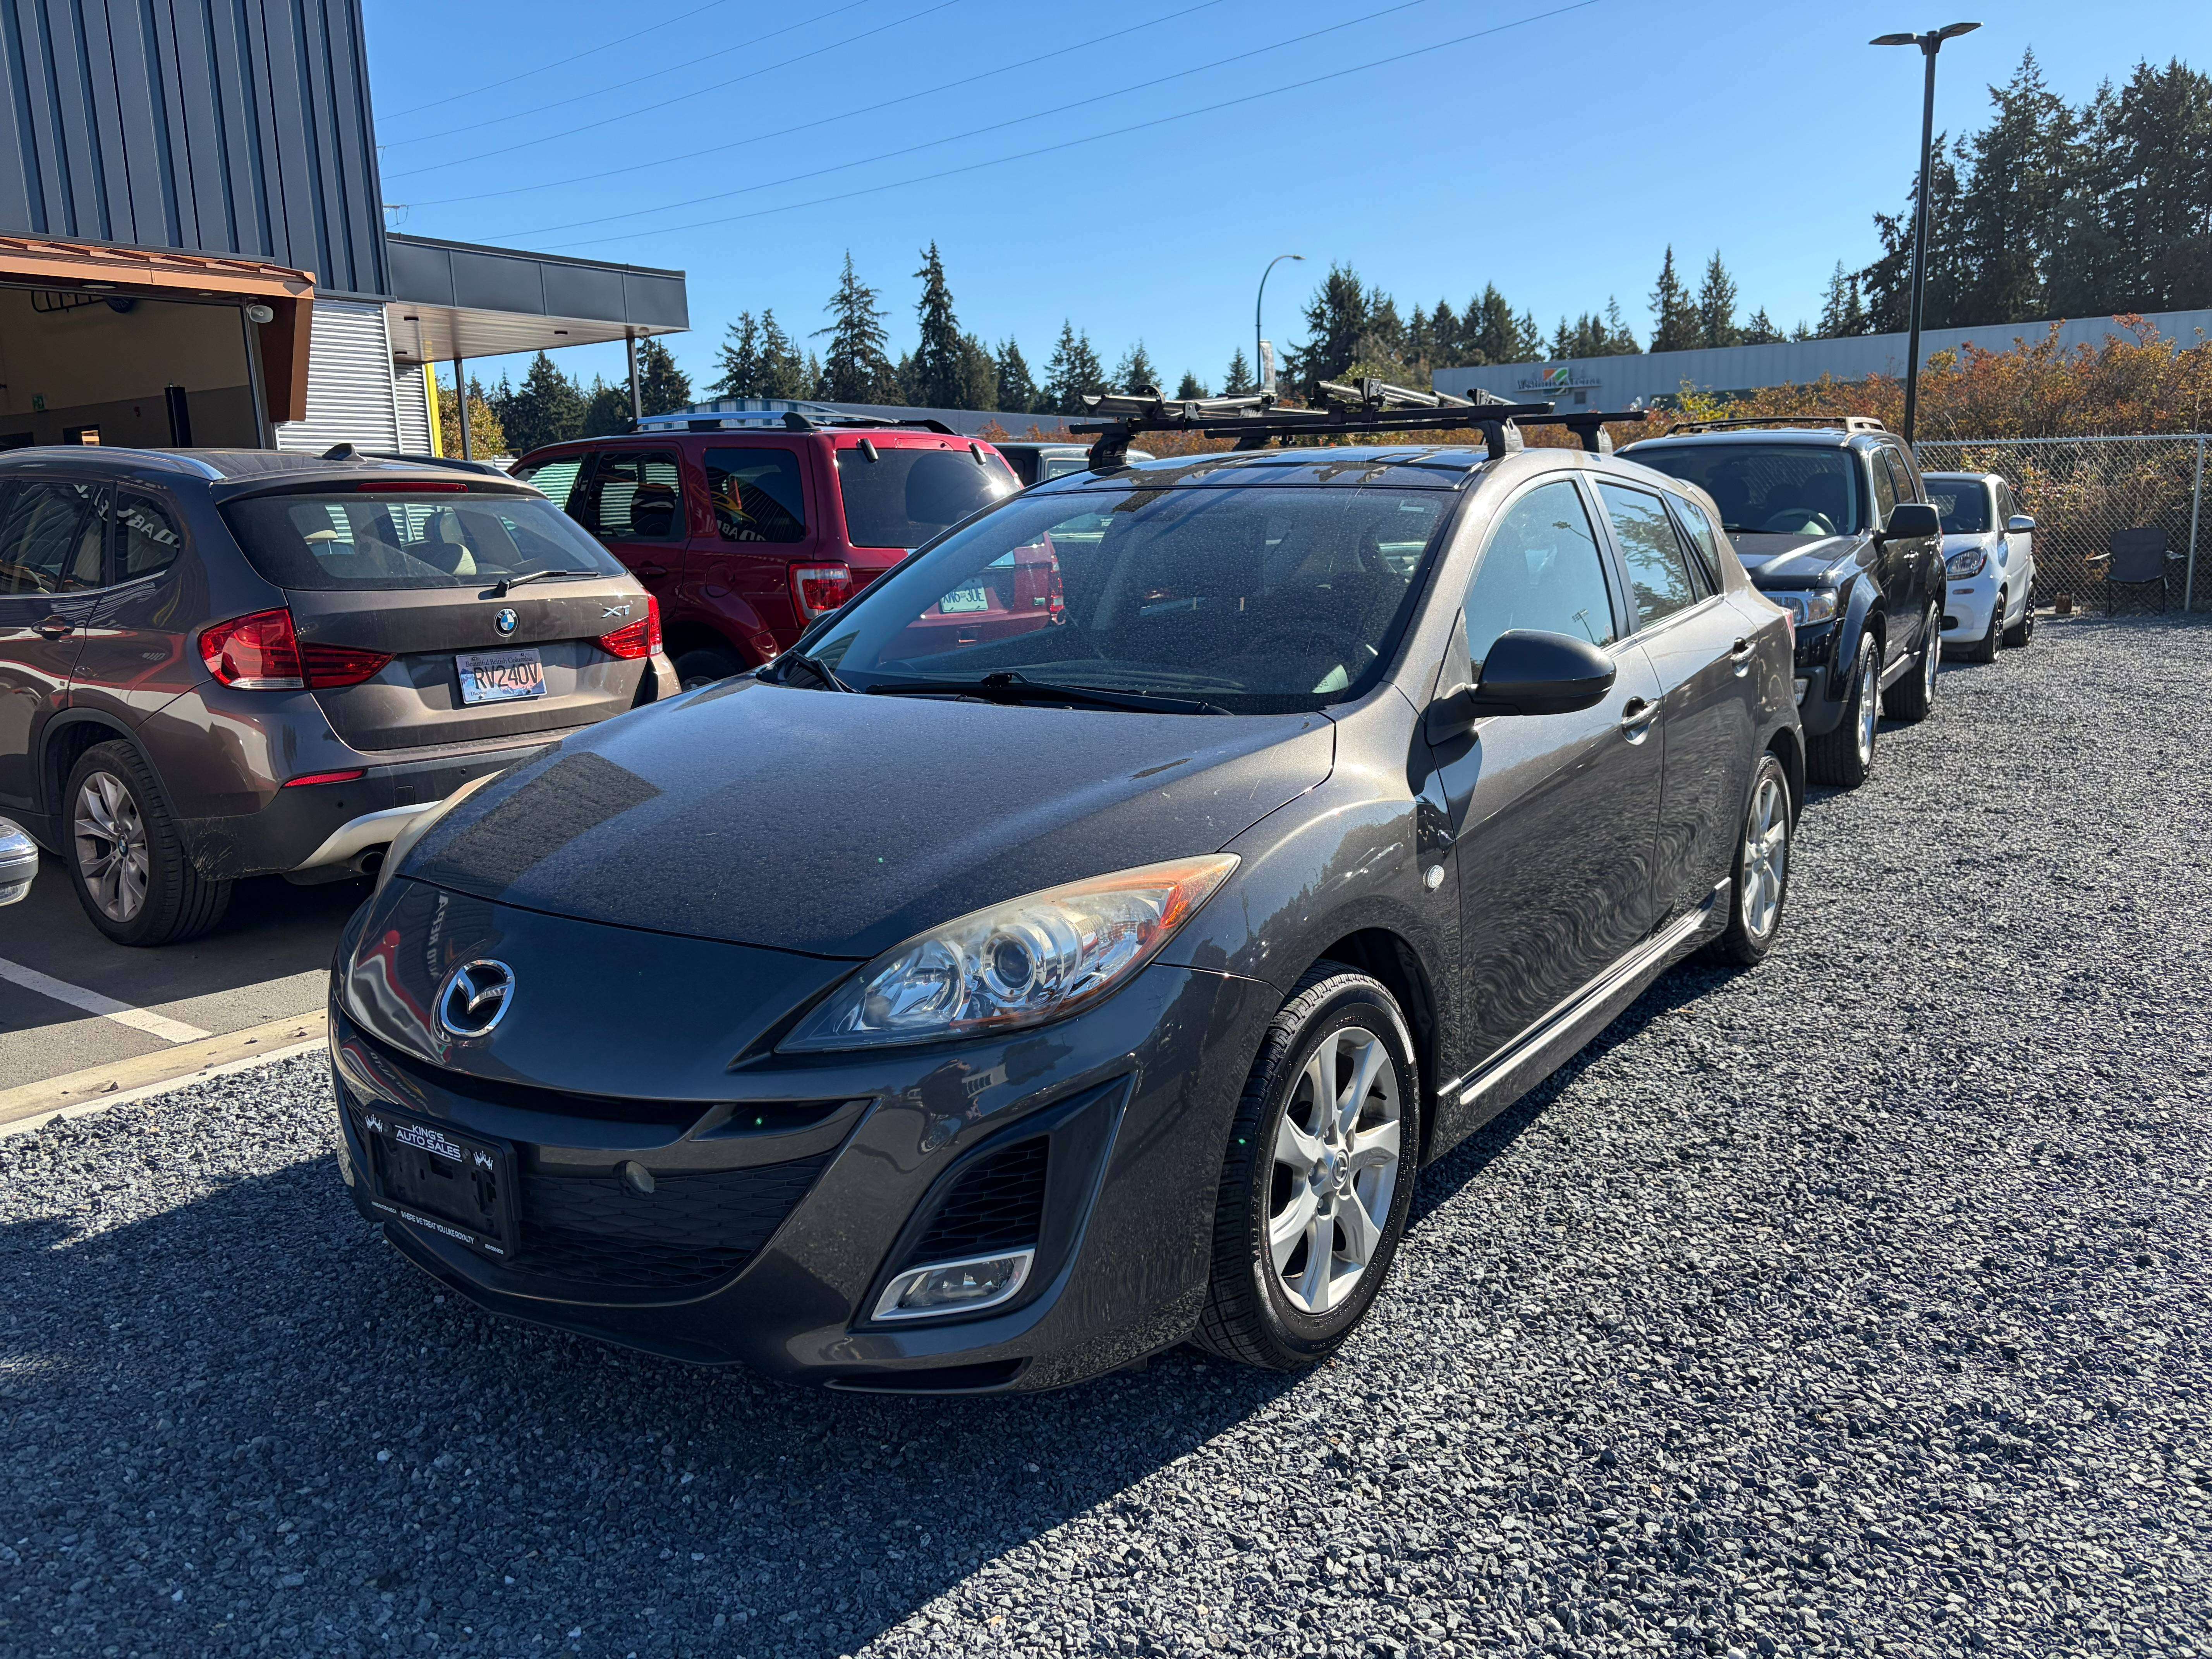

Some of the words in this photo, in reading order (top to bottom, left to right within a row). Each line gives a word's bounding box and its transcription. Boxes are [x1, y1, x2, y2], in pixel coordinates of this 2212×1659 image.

[600, 605, 630, 618] X1
[474, 662, 538, 690] RV240V
[397, 1130, 425, 1146] AUTO
[427, 1139, 461, 1158] SALES
[412, 1124, 445, 1143] KING'S
[400, 1211, 416, 1222] WHERE
[416, 1216, 423, 1225] WE
[423, 1219, 436, 1230] TREAT
[436, 1224, 445, 1233] YOU
[446, 1227, 455, 1237] LIKE
[455, 1230, 474, 1244] ROYALTY
